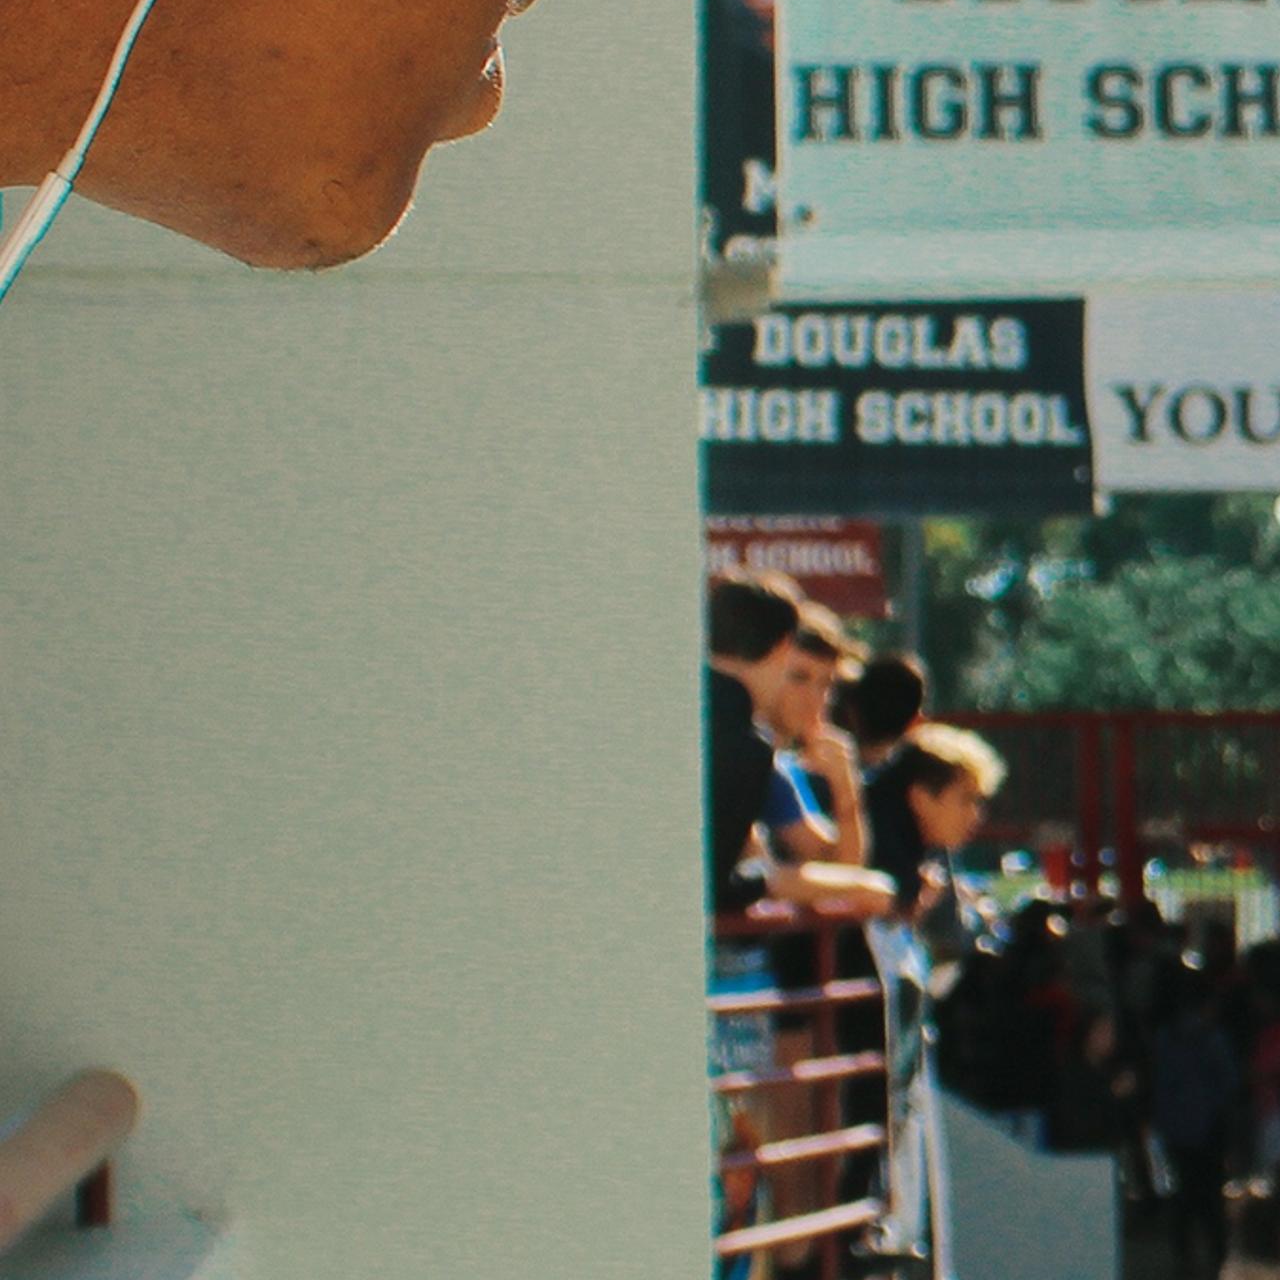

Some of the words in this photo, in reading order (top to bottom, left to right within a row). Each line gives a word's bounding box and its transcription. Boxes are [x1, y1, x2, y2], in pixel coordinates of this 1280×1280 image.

[792, 60, 1045, 144] HIGH
[752, 314, 1029, 370] DOUGLAS
[701, 386, 841, 444] HIGH
[853, 389, 1084, 447] SCHOOL
